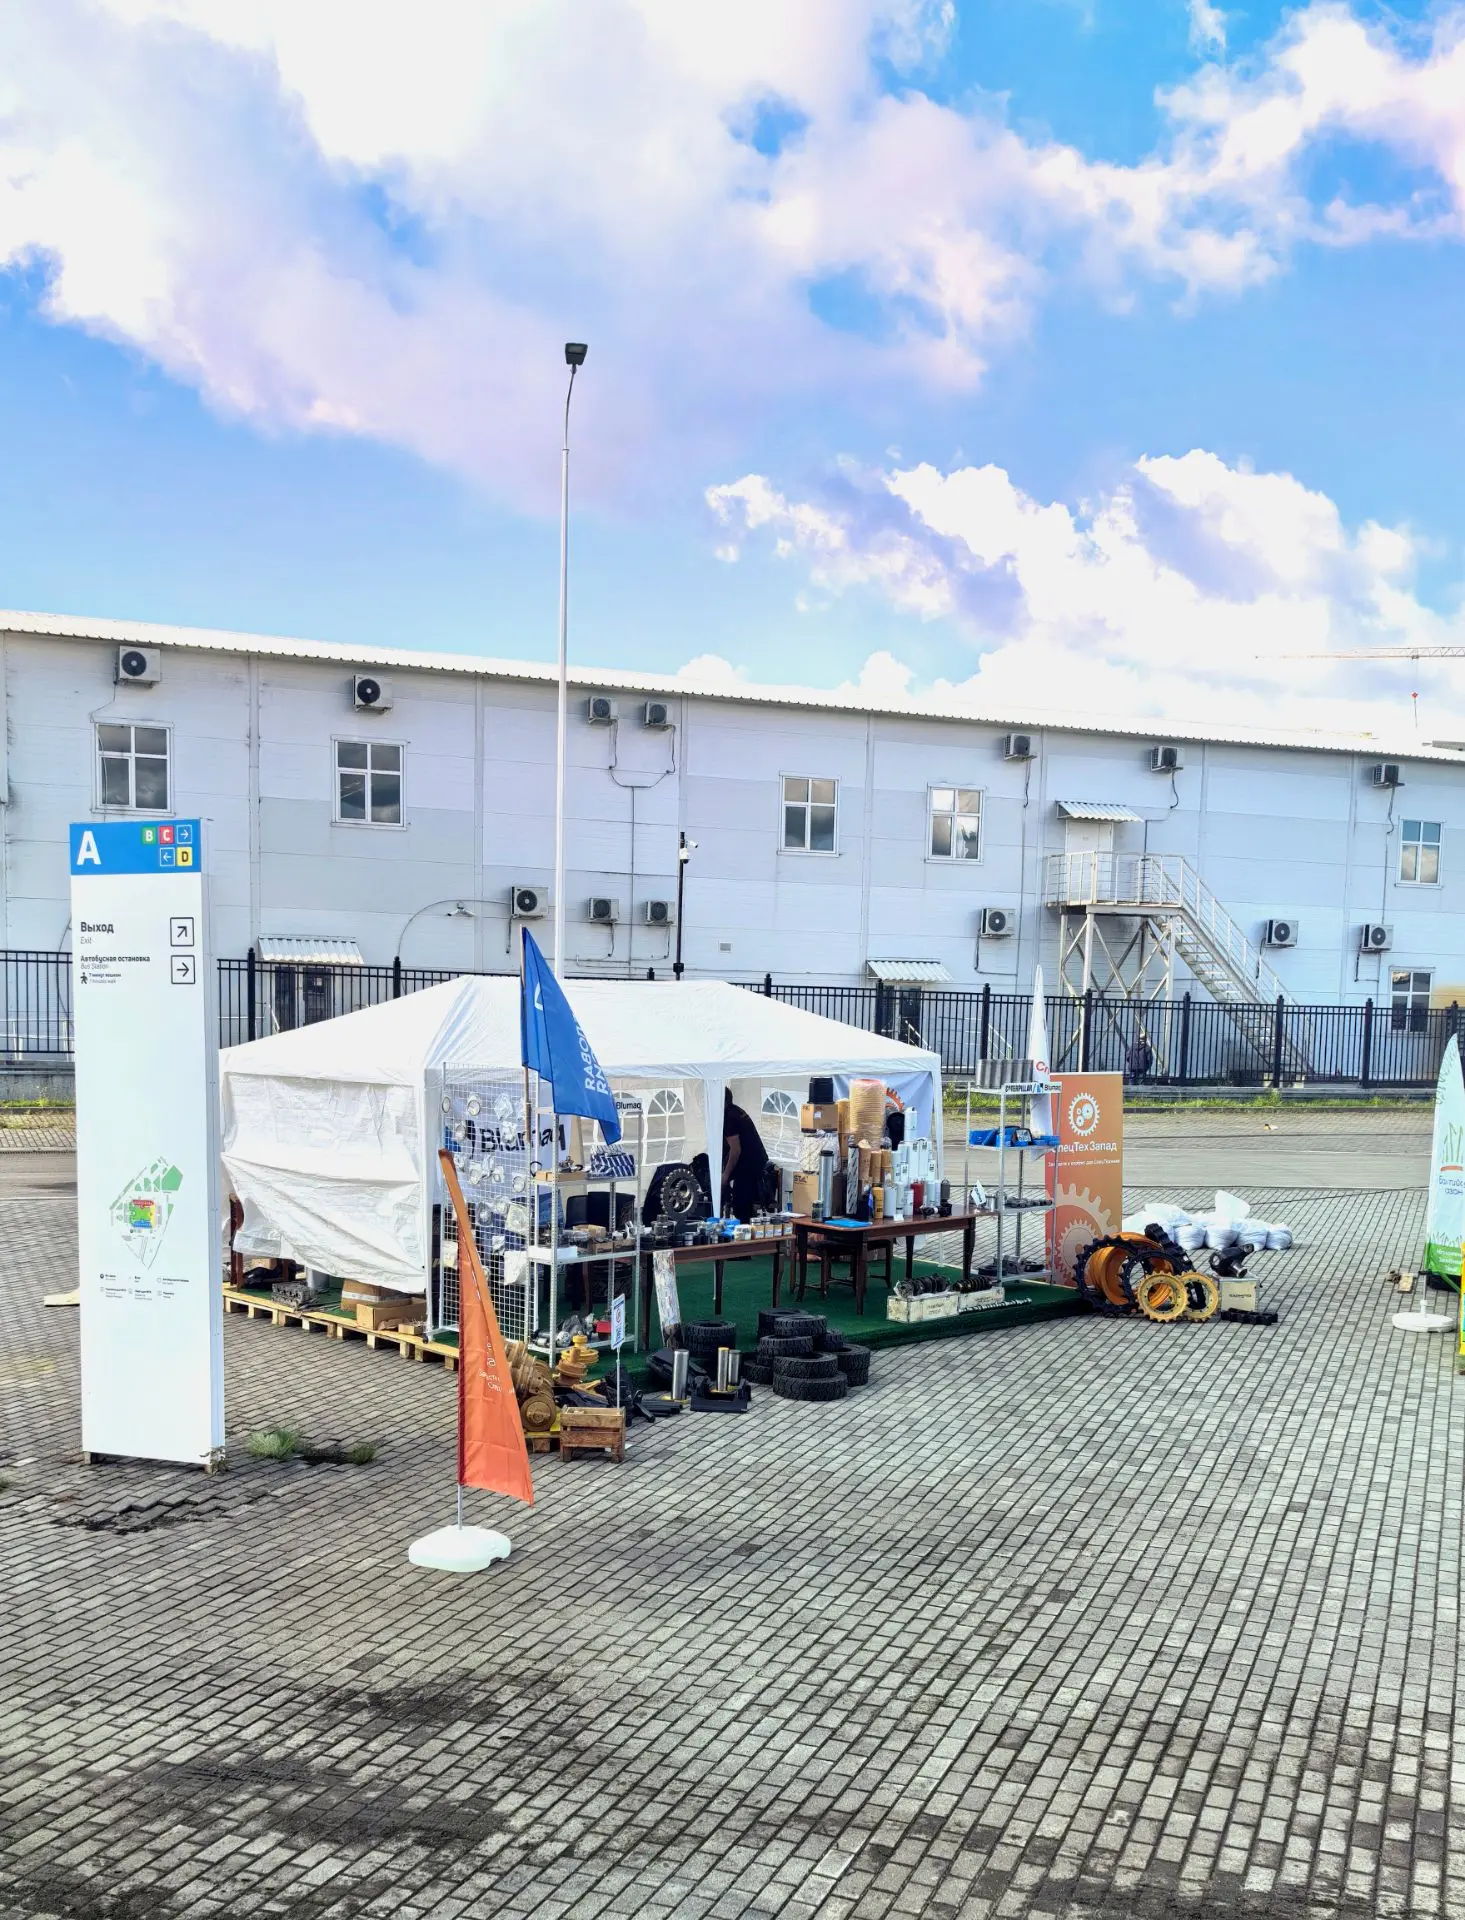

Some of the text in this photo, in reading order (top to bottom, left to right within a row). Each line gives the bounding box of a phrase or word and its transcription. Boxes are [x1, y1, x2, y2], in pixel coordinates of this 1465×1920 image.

[145, 829, 171, 842] B C
[76, 830, 102, 866] A
[181, 851, 189, 862] D
[80, 921, 115, 934] Выход
[80, 936, 92, 945] Exit
[80, 955, 117, 963] Автобусная
[615, 1101, 642, 1111] Blumaq
[1051, 1140, 1117, 1153] пецТехЗапад
